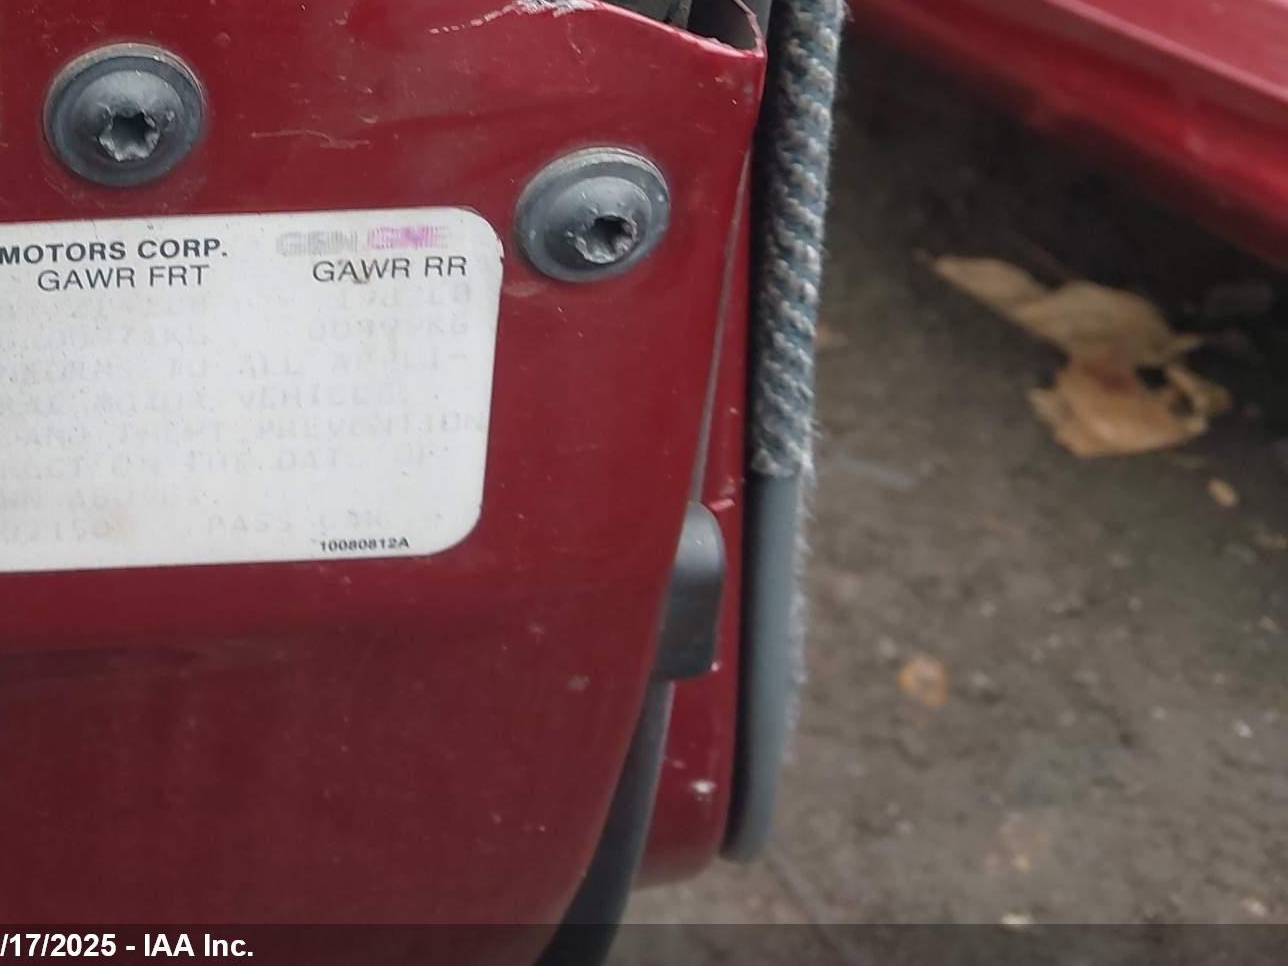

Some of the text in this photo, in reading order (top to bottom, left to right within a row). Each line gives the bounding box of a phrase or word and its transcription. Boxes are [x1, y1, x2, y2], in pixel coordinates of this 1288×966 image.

[138, 239, 227, 259] CORP.
[38, 265, 209, 291] GAWR FRT
[313, 256, 466, 284] GAWR RR
